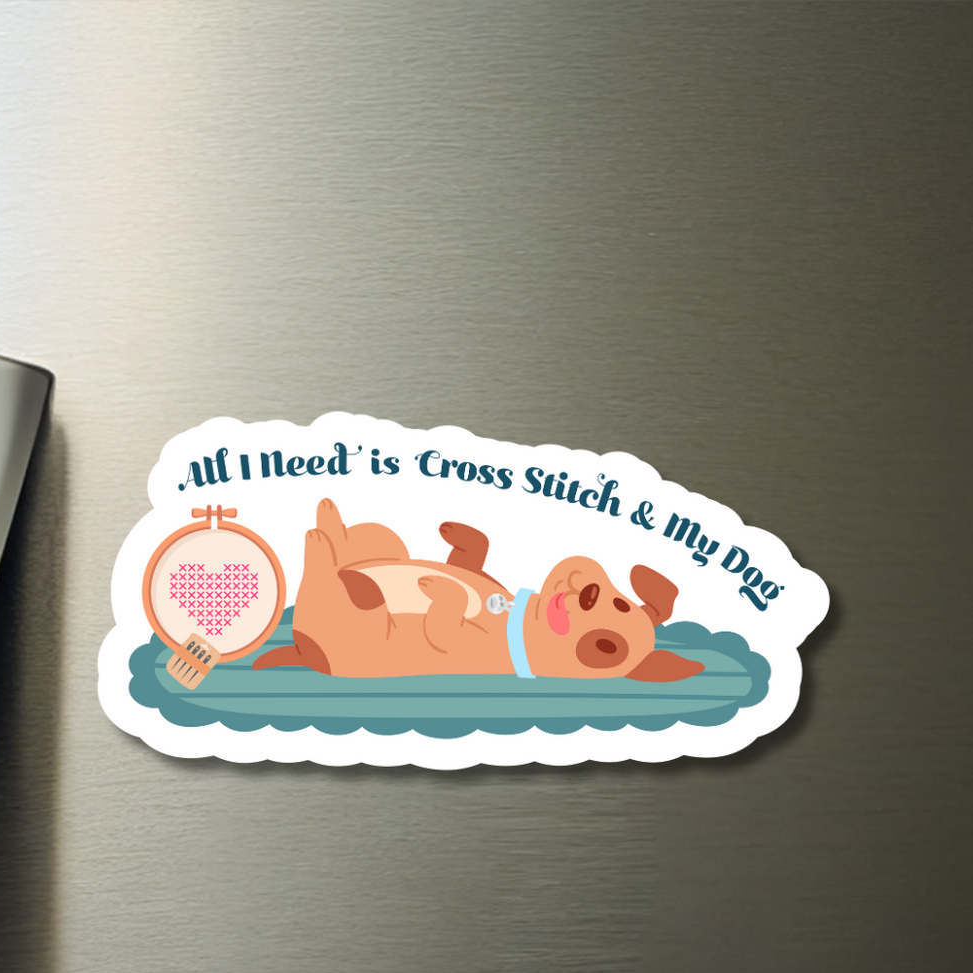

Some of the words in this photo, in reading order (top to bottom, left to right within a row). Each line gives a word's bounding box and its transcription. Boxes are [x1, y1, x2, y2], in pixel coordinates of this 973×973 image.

[178, 447, 233, 491] All
[240, 454, 251, 480] I
[260, 442, 363, 479] Need
[371, 448, 400, 475] is
[414, 450, 514, 490] Cross
[522, 466, 623, 517] Stitch
[630, 500, 656, 531] &
[662, 512, 720, 567] My
[720, 545, 785, 612] Dog
